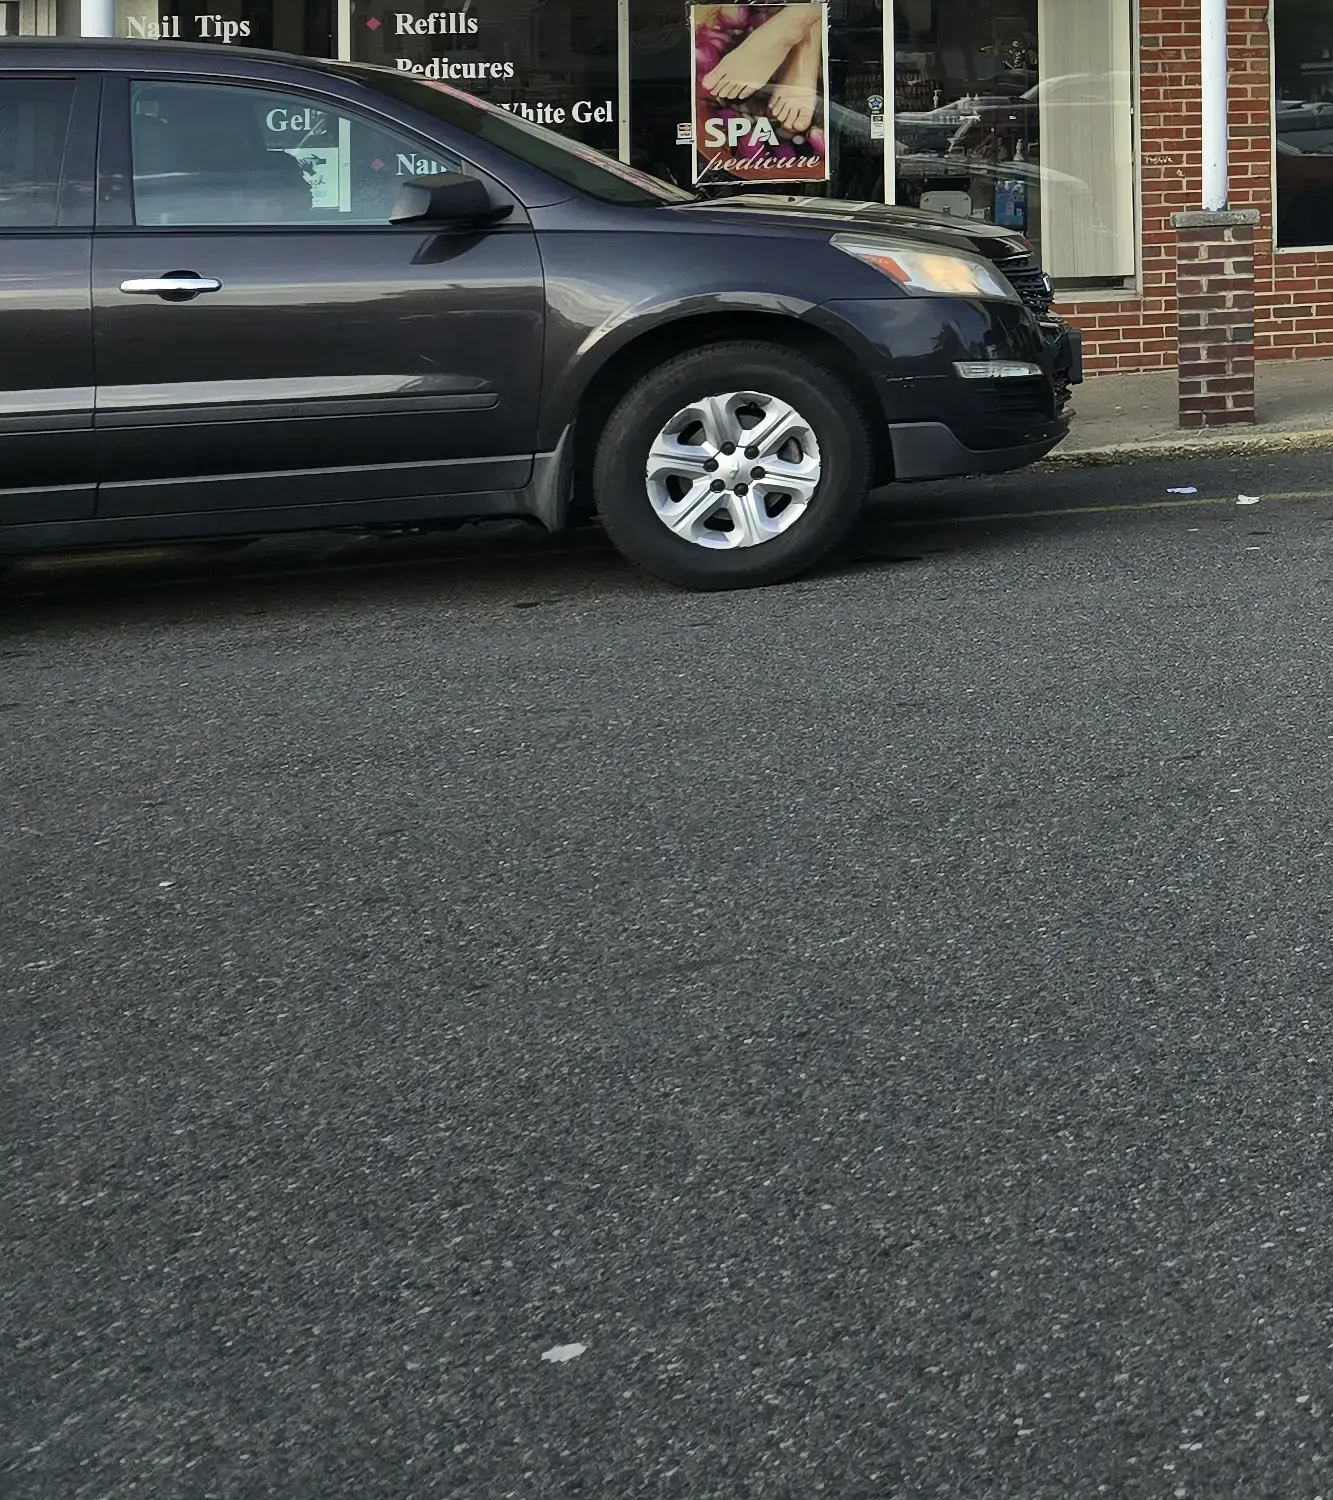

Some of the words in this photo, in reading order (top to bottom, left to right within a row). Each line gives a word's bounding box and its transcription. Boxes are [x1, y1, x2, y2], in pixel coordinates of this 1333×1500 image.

[126, 15, 181, 39] Nail
[194, 14, 251, 44] Tips
[395, 12, 479, 36] Refills
[265, 108, 312, 132] Gel
[571, 101, 614, 123] Gel
[704, 116, 780, 148] SPA
[695, 144, 821, 188] pedicure
